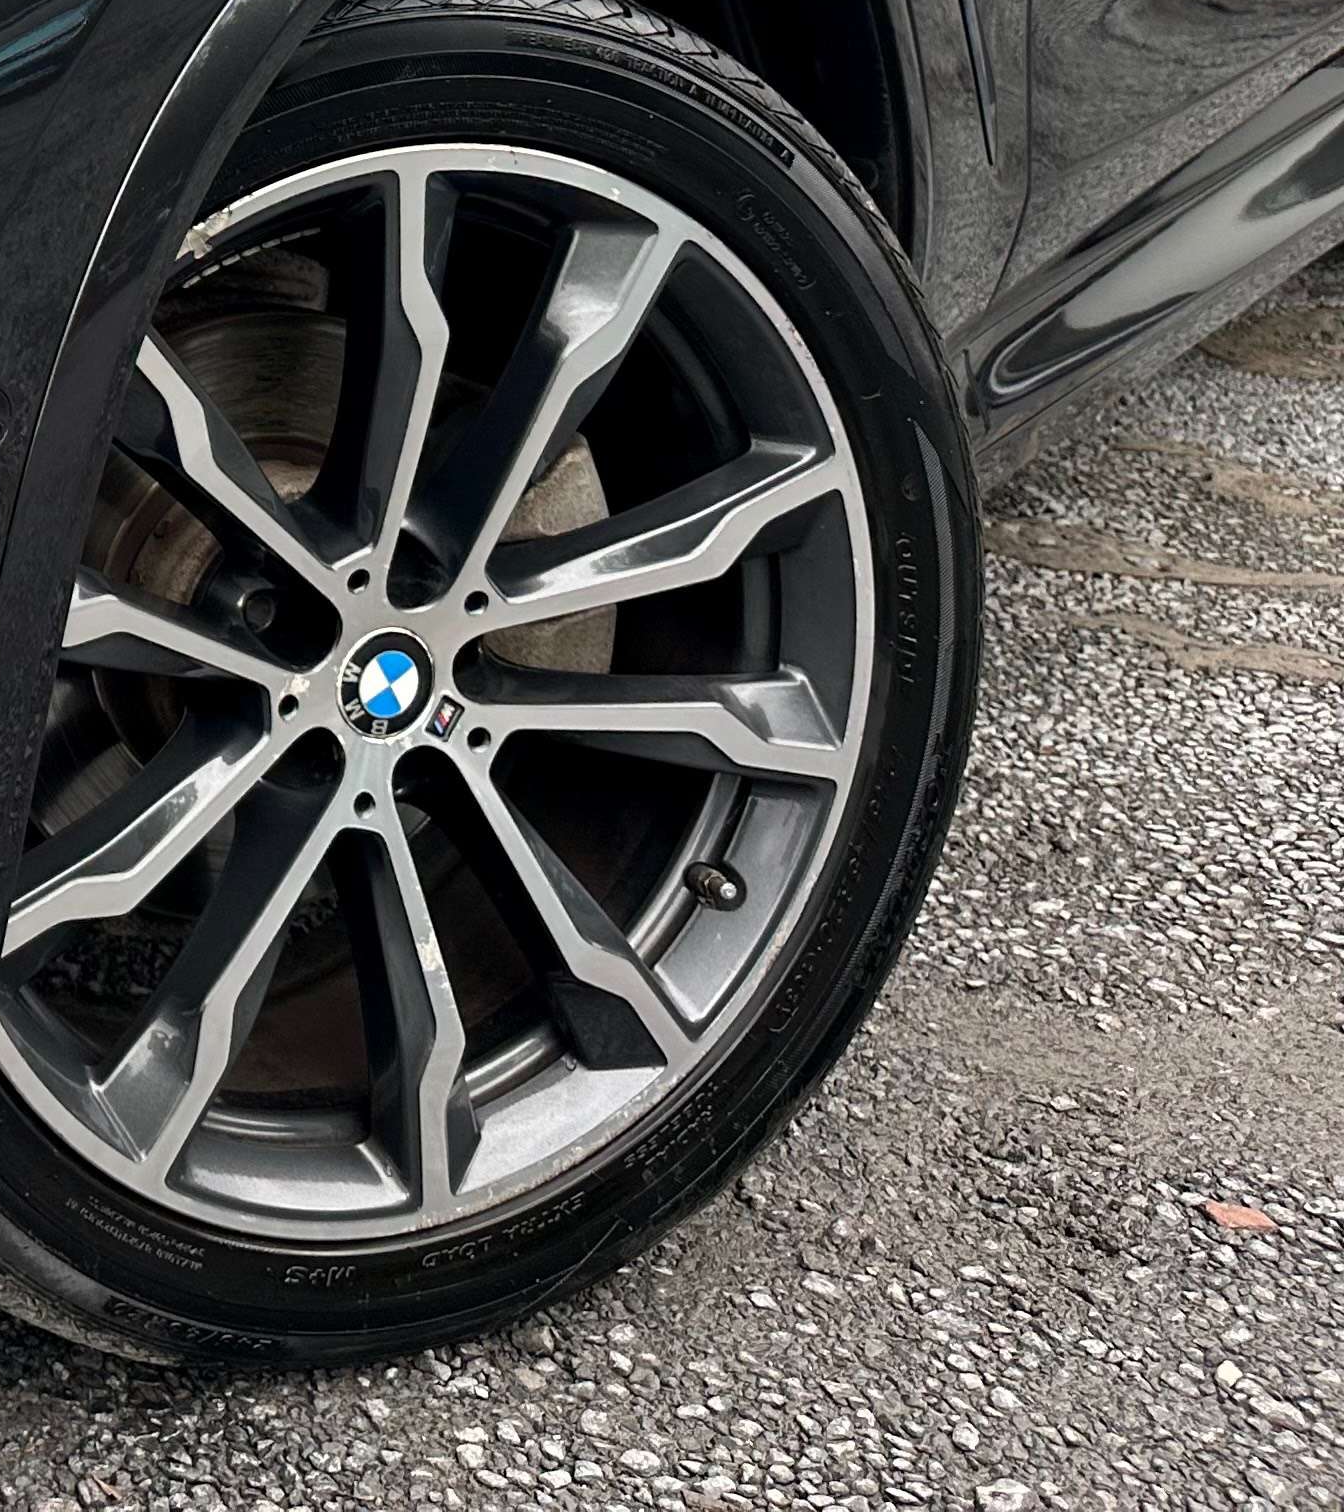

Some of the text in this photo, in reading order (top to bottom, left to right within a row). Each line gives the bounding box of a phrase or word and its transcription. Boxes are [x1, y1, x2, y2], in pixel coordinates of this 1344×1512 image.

[340, 661, 389, 736] BMW
[421, 1190, 586, 1268] EXTRA LOAD
[284, 1264, 357, 1287] M+S
